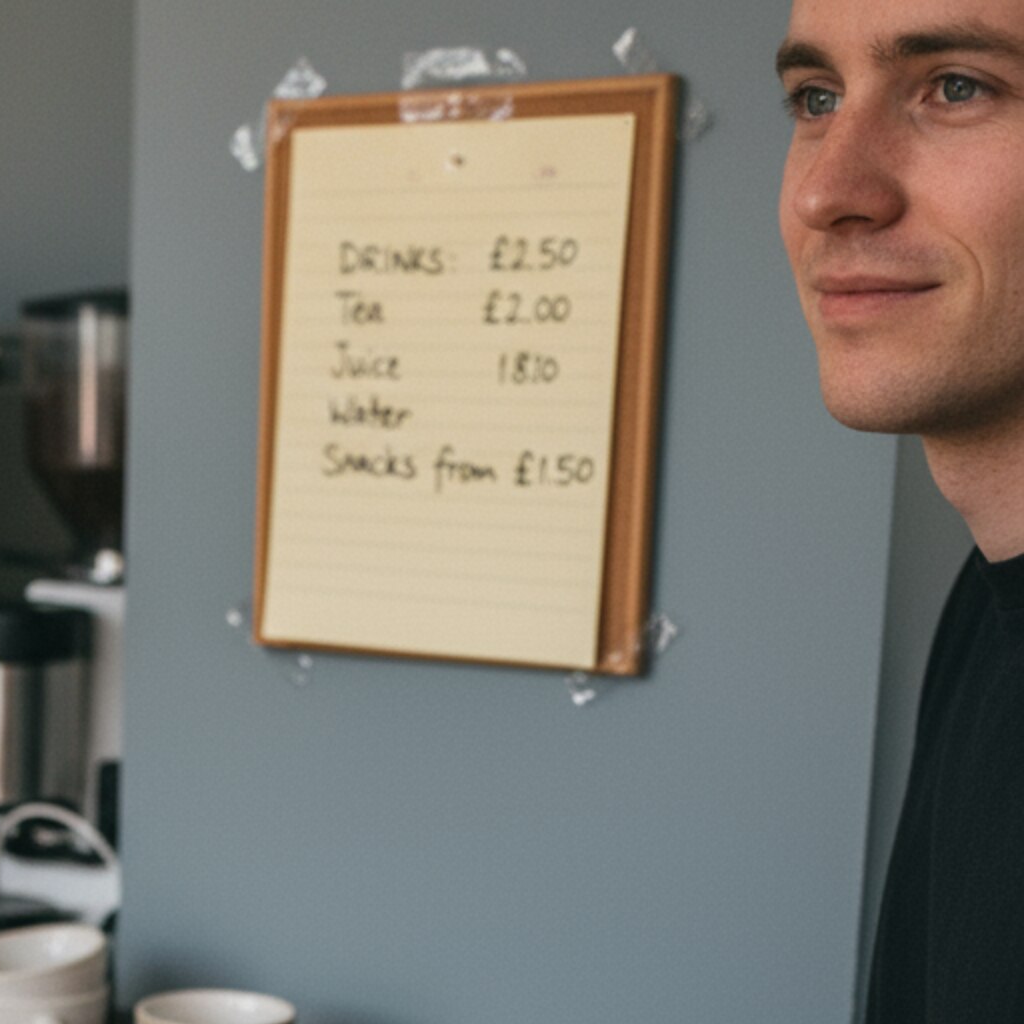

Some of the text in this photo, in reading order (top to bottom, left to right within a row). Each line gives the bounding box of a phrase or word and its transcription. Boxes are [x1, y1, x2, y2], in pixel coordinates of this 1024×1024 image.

[489, 235, 580, 271] £2.50
[334, 290, 572, 325] Tea £2.00
[330, 341, 401, 380] Juice
[328, 396, 412, 429] Water
[322, 442, 596, 494] Snacks from £1.50
